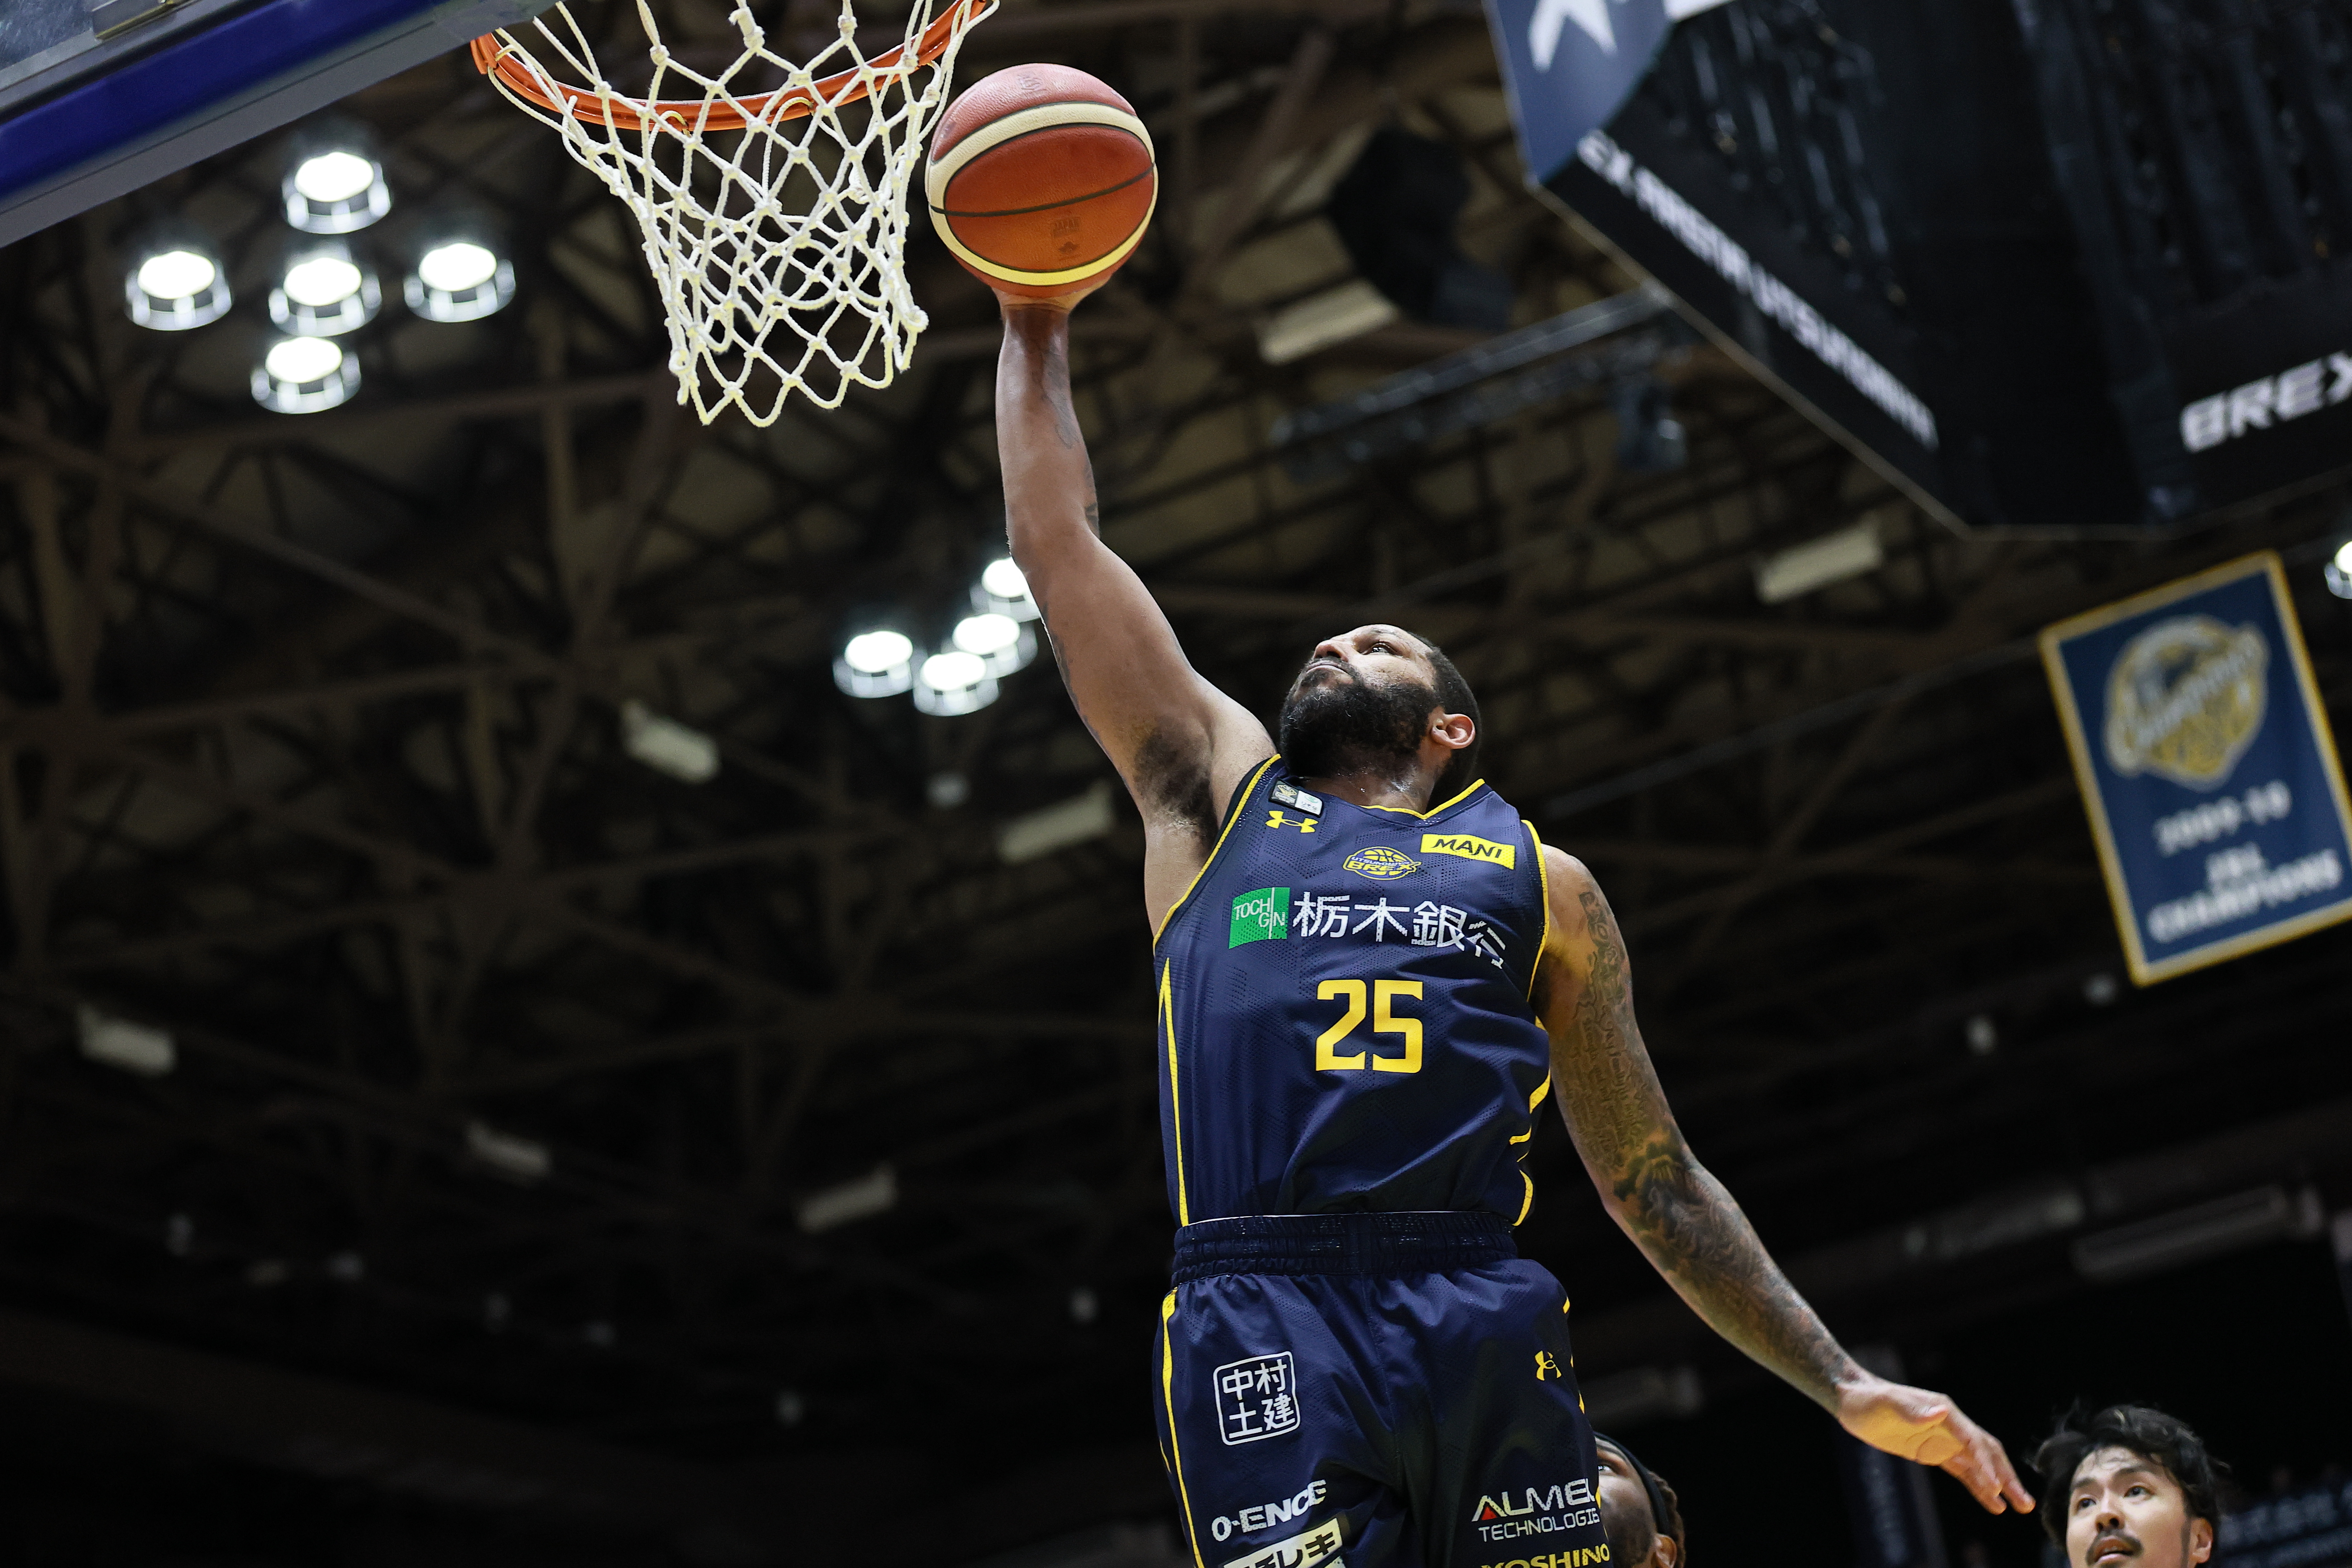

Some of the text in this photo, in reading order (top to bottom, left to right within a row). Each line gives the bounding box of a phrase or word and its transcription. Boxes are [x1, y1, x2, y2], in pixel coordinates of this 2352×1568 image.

[1347, 860, 1415, 871] BREX
[1431, 839, 1502, 858] MANI
[1258, 911, 1286, 928] GIN
[1293, 891, 1506, 969] 栃木銀行
[1315, 979, 1423, 1073] 25
[1222, 1359, 1287, 1400] 中村
[1229, 1392, 1296, 1439] 土建
[1471, 1478, 1595, 1522] ALME
[1481, 1543, 1610, 1568] SHINO
